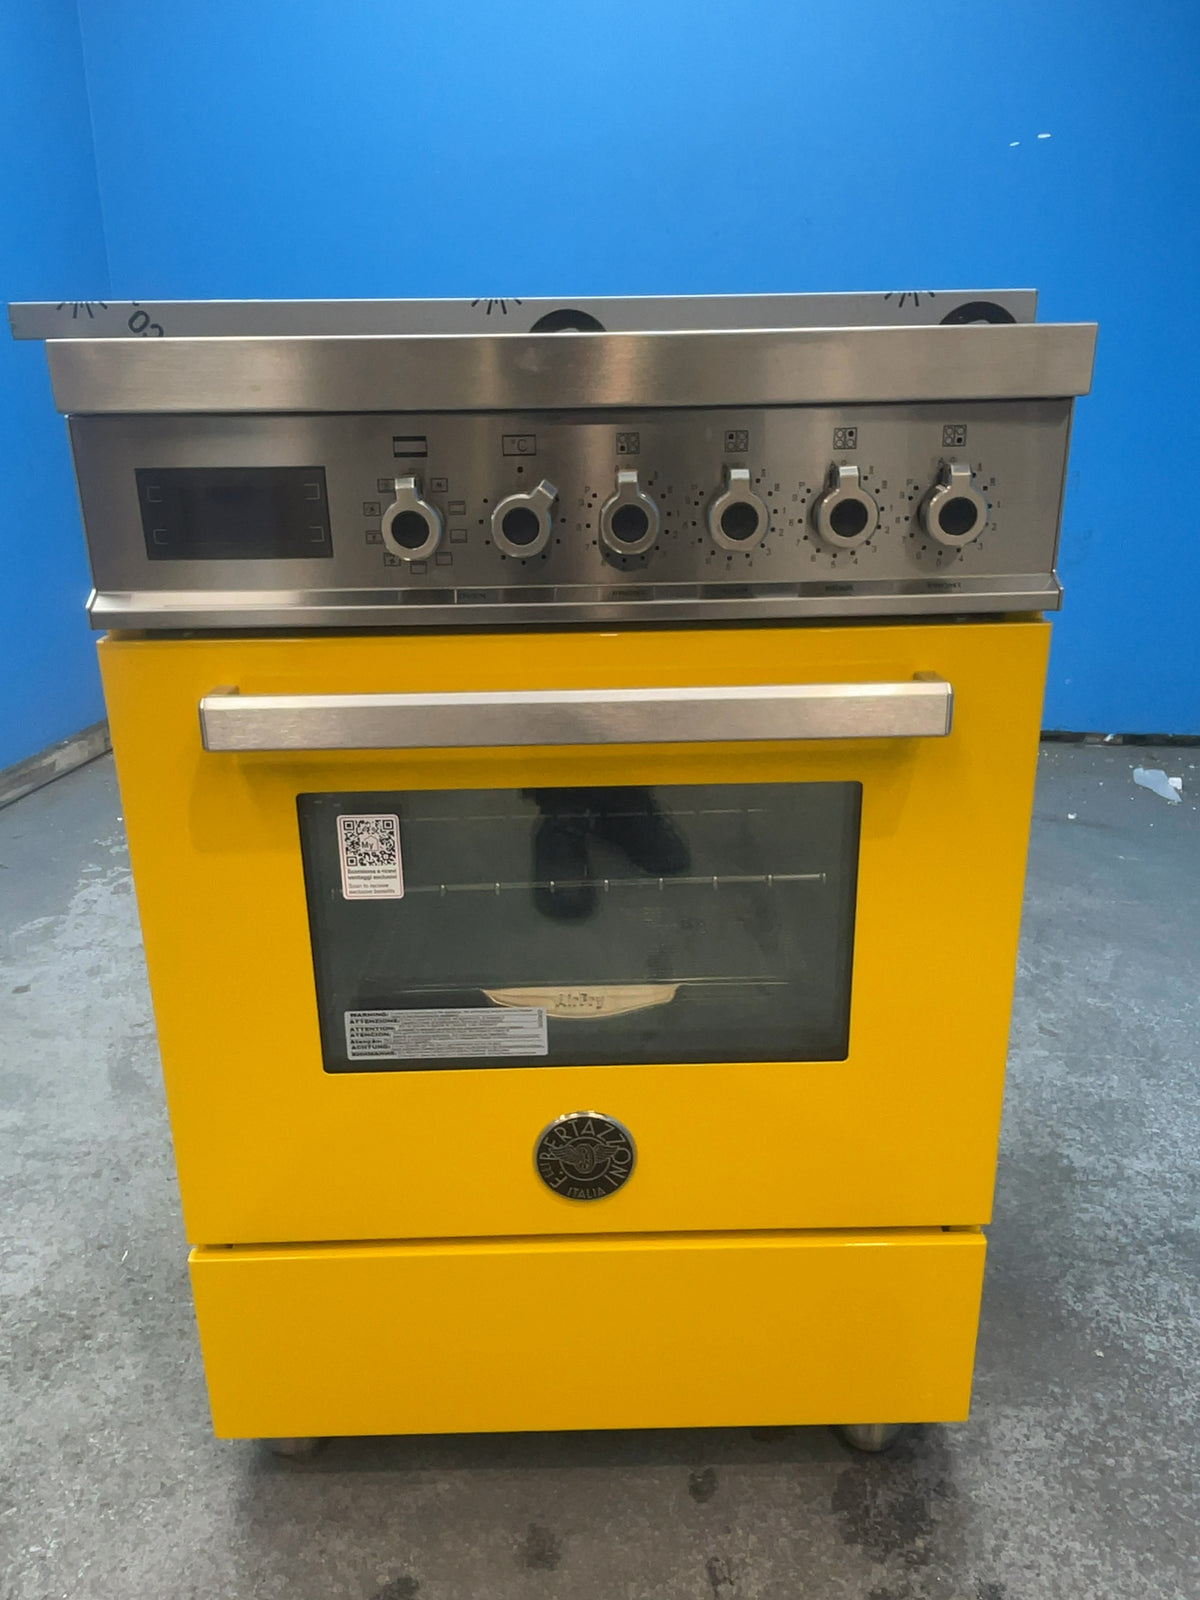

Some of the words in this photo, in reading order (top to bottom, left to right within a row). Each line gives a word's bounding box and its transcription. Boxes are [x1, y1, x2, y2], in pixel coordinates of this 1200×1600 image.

[361, 841, 374, 851] My
[539, 1119, 632, 1187] BERTAZZONI
[566, 1186, 607, 1199] ITALIA
